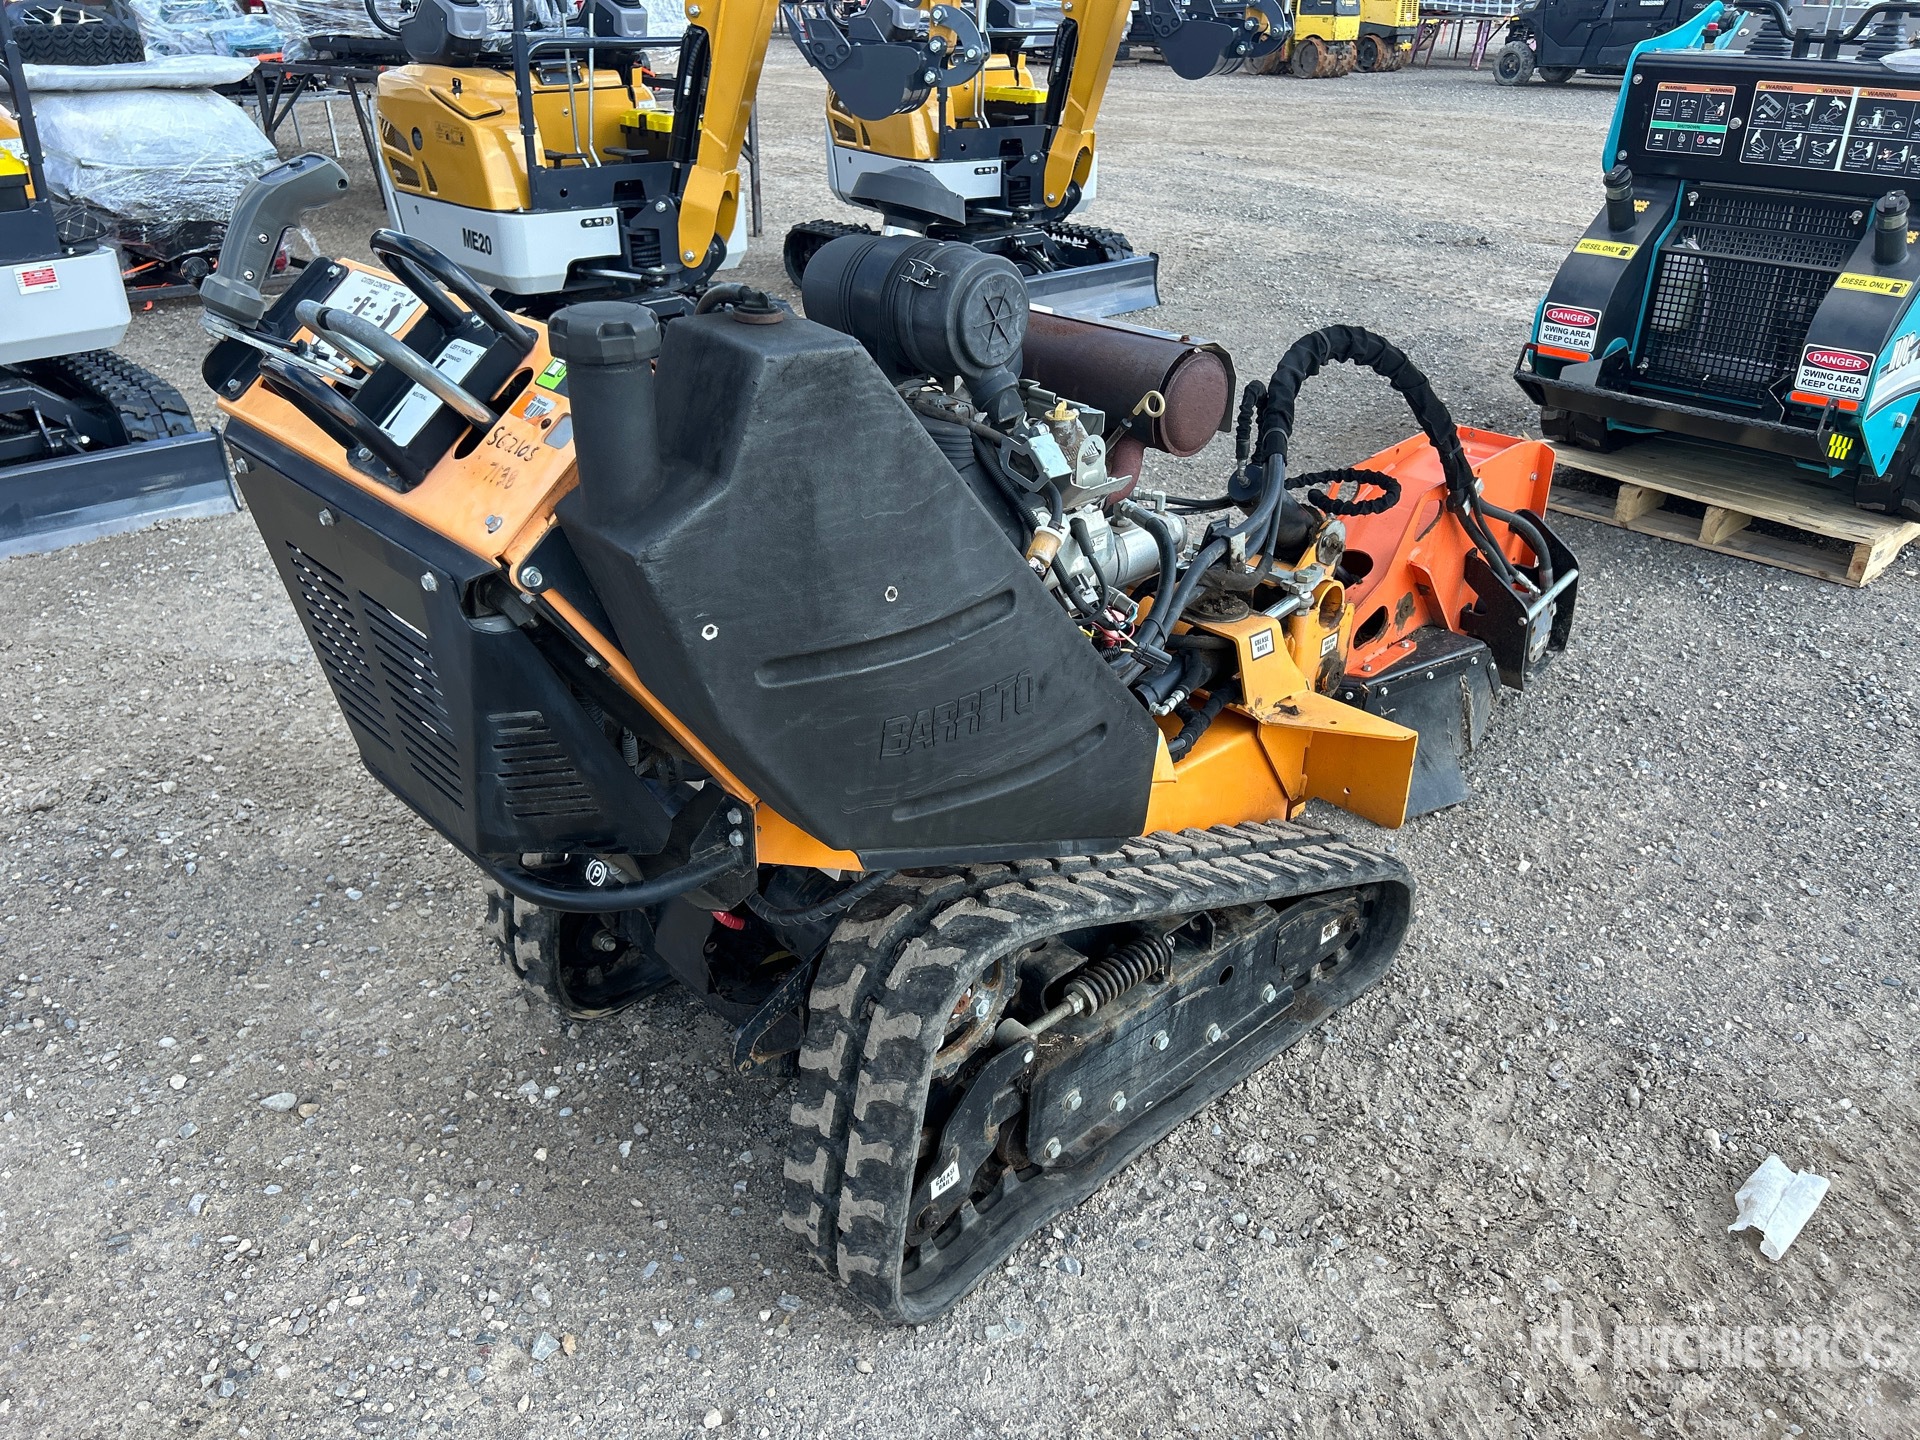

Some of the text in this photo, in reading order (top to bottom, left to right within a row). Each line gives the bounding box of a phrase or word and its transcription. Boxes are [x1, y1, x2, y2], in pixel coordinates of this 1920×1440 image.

[462, 228, 492, 256] ME20
[1579, 242, 1621, 253] DIESEL ONLY
[1841, 277, 1892, 290] DIESEL ONLY
[1551, 310, 1590, 324] DANGER
[1545, 325, 1591, 339] SWING AREA
[1543, 333, 1590, 348] KEEP CLEAR
[1812, 353, 1862, 369] DANGER
[1803, 368, 1862, 386] SWING AREA
[1800, 378, 1860, 396] KEEP CLEAR
[880, 668, 1034, 760] BARRETO
